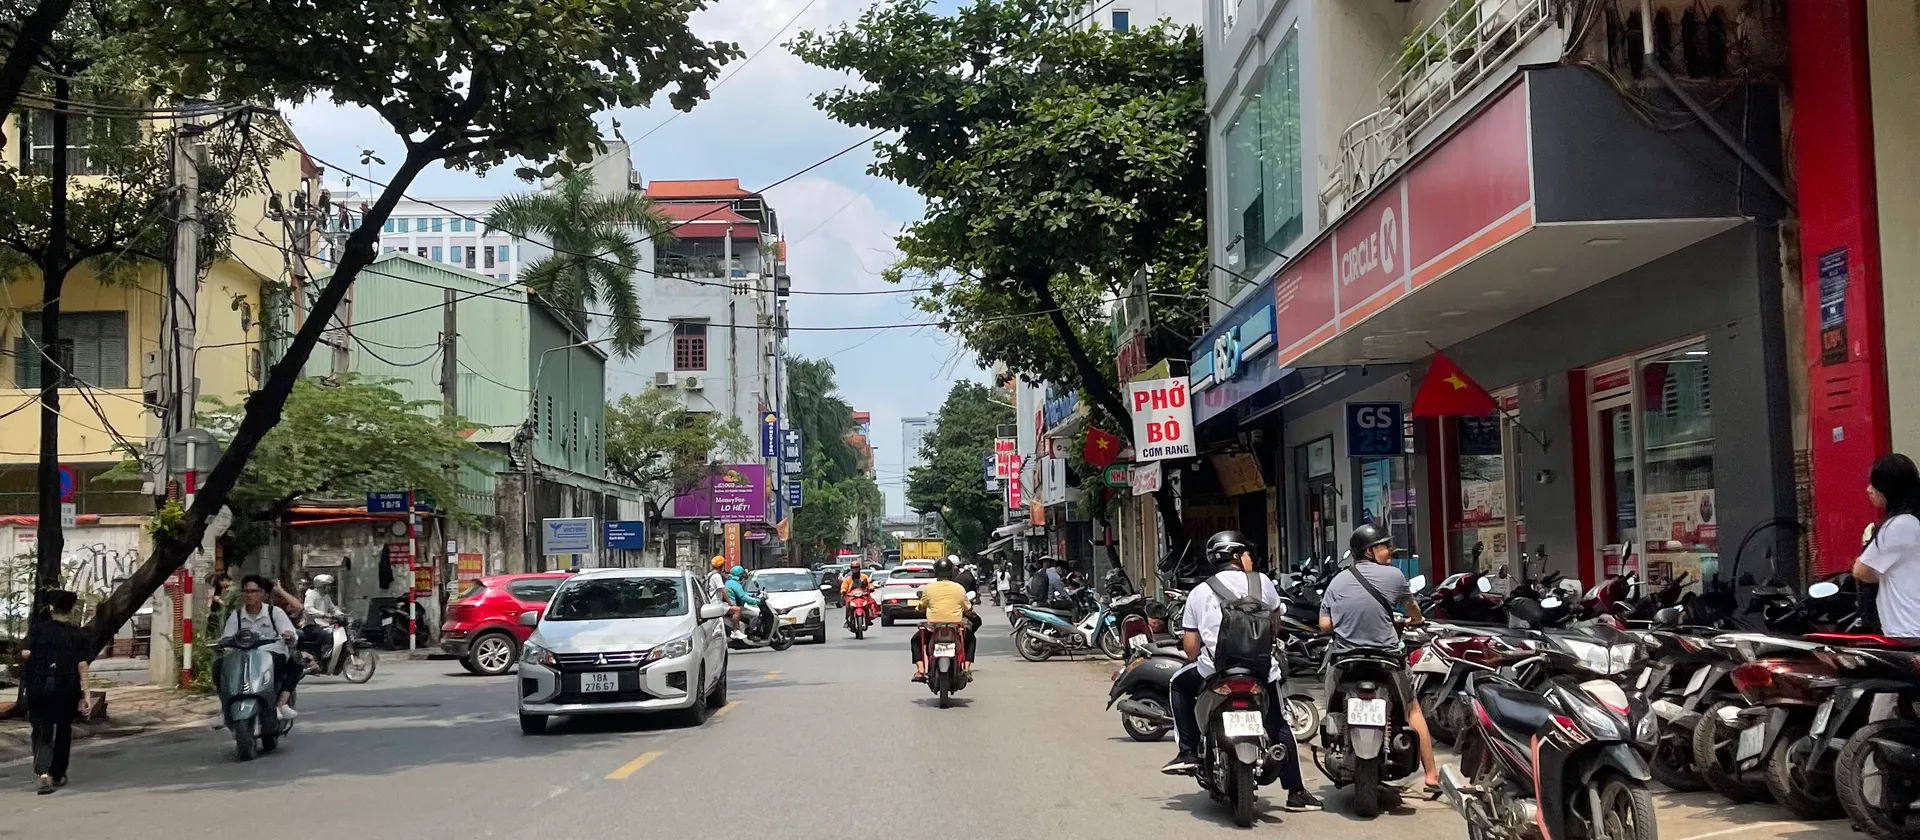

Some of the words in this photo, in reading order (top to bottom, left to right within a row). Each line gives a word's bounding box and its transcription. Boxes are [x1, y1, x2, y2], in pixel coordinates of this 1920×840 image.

[1342, 231, 1378, 286] CIRCLE
[1134, 380, 1186, 412] PHỞ
[1356, 406, 1392, 429] GS
[1146, 416, 1181, 443] BÒ
[1142, 446, 1163, 458] CƠM
[1165, 444, 1190, 456] RANG
[1360, 430, 1392, 452] 25
[720, 504, 731, 512] LO
[592, 673, 608, 682] 18A
